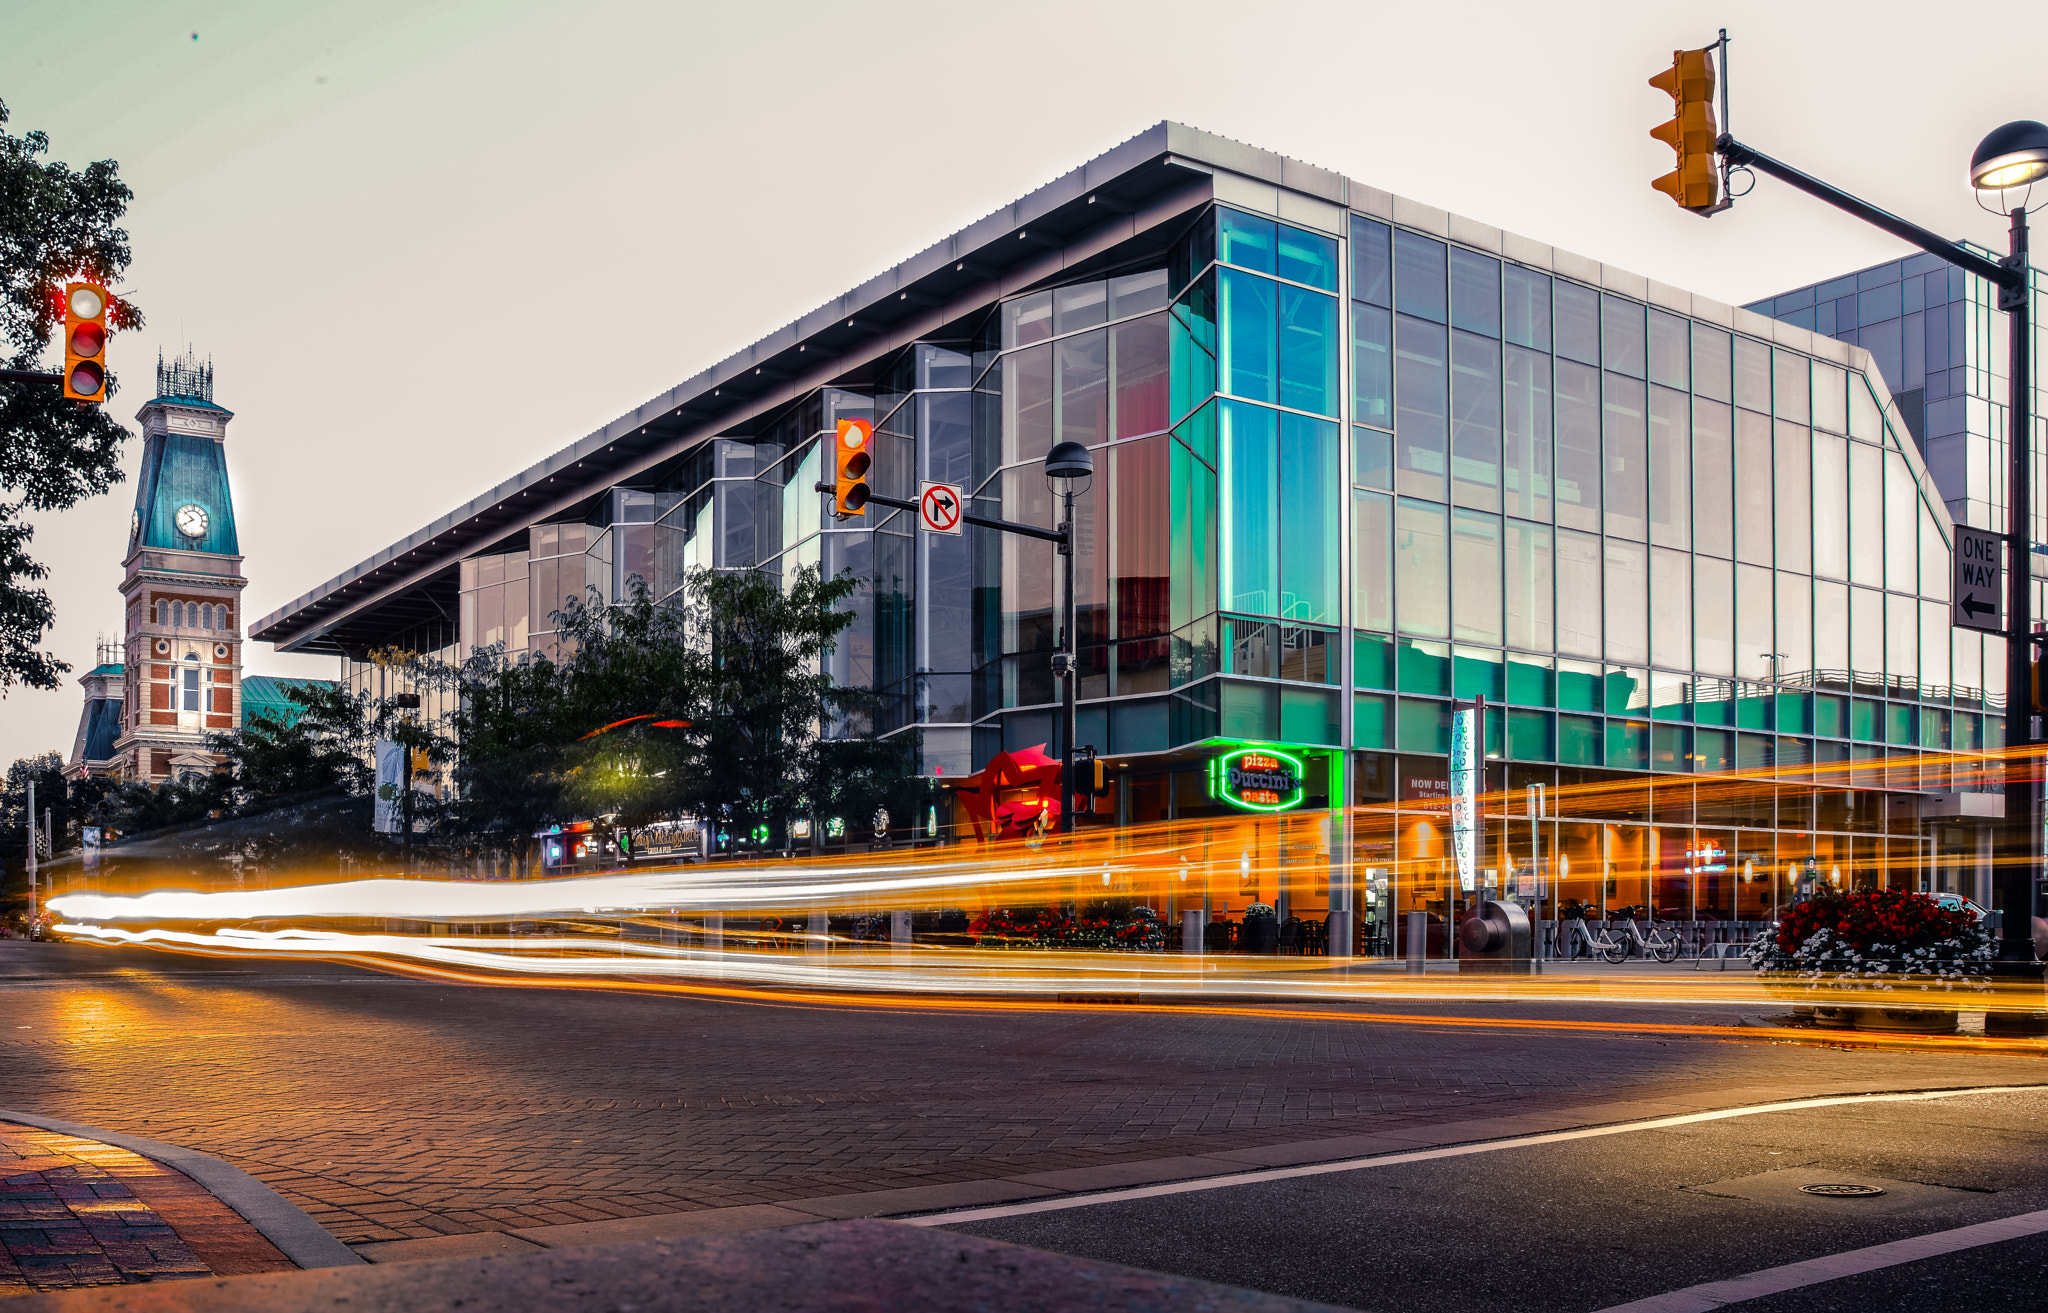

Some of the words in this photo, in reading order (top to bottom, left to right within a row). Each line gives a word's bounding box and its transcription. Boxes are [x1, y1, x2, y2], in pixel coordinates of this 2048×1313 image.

[1963, 536, 1994, 562] ONE
[1963, 562, 1995, 588] WAY
[1244, 753, 1278, 769] pizza
[1228, 767, 1300, 790] Puccini's
[1411, 779, 1432, 788] NOW
[1243, 790, 1278, 804] pasta
